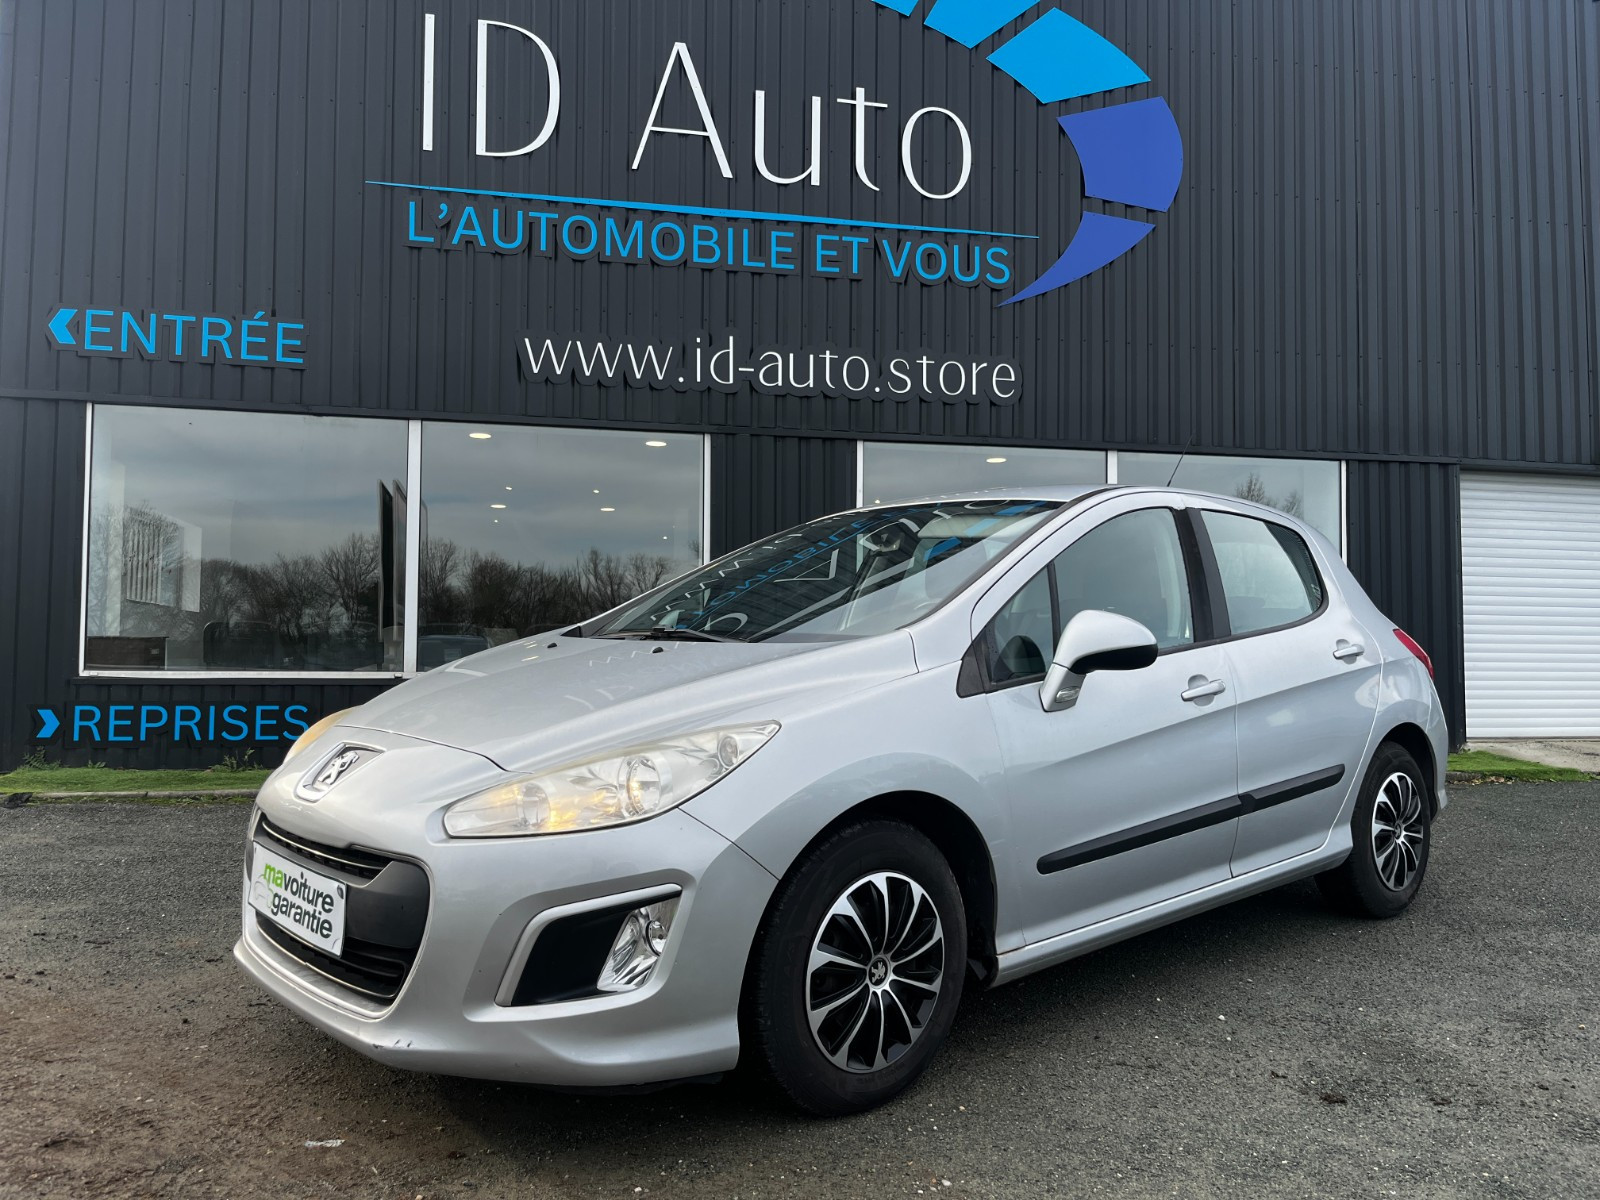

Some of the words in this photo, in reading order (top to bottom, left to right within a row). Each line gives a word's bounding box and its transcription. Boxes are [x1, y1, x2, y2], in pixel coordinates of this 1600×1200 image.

[422, 12, 561, 157] ID
[631, 41, 972, 200] Auto
[408, 200, 796, 270] L'AUTOMOBILE
[815, 233, 870, 275] ET
[882, 239, 1011, 285] VOUS
[83, 308, 305, 364] ENTRÉE
[524, 335, 1016, 398] www.id-auto.store
[73, 704, 309, 742] REPRISES
[270, 892, 333, 939] garantie
